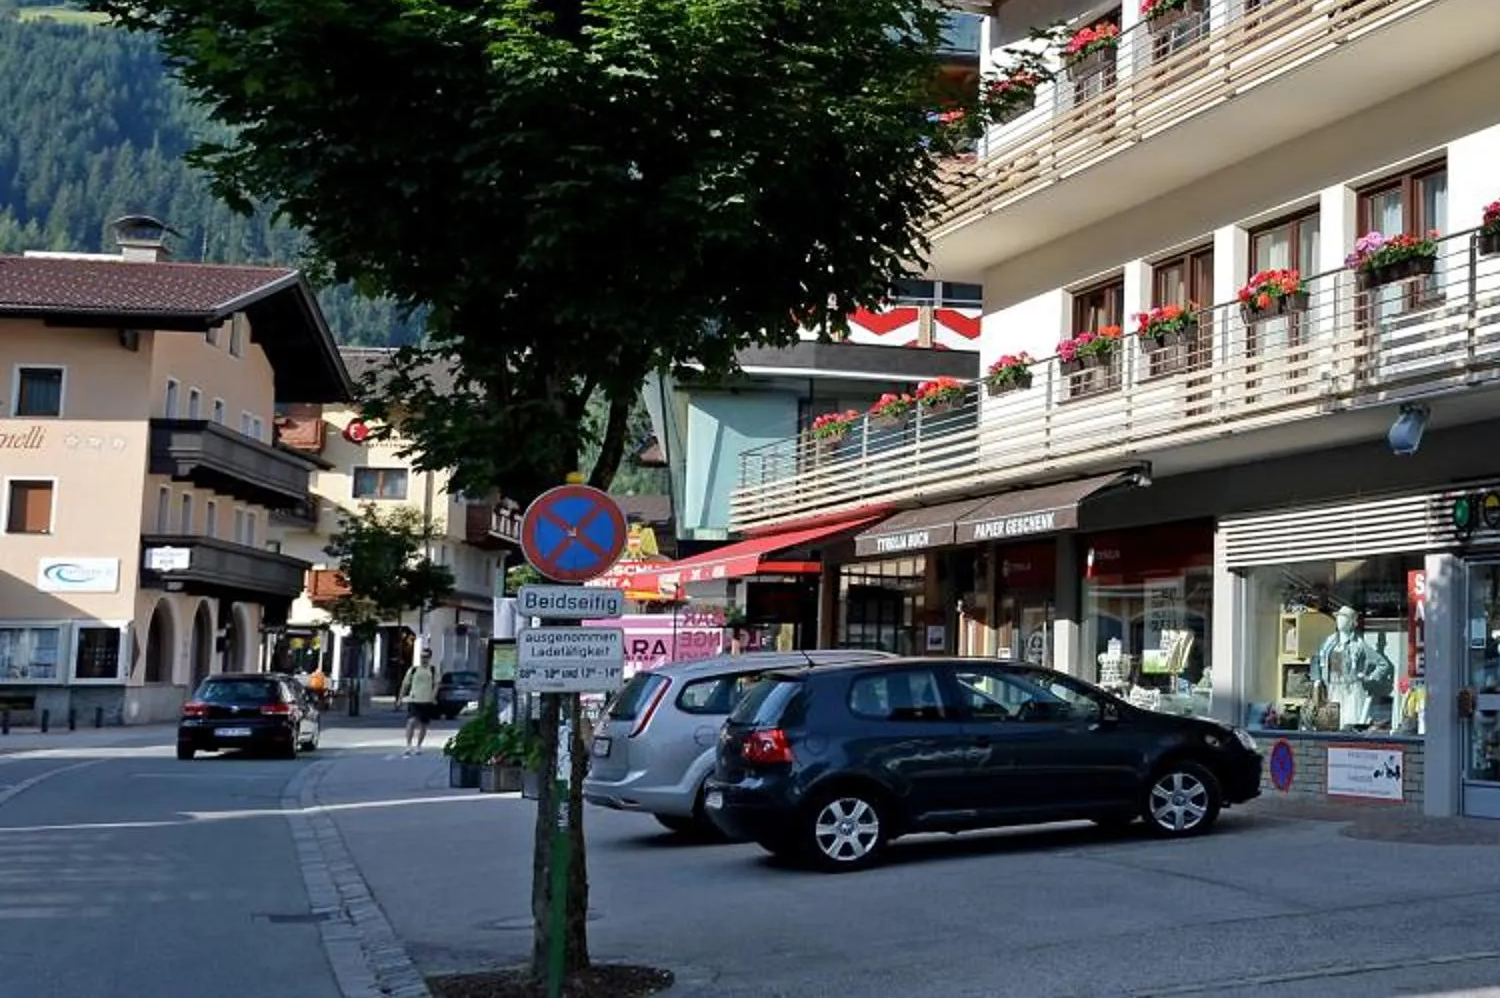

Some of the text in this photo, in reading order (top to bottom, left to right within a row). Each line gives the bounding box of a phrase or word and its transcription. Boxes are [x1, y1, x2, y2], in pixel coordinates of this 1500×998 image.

[974, 512, 1056, 539] PAPIER GESCHENK
[525, 591, 617, 615] Beidseitig
[525, 632, 617, 645] ausgenommen
